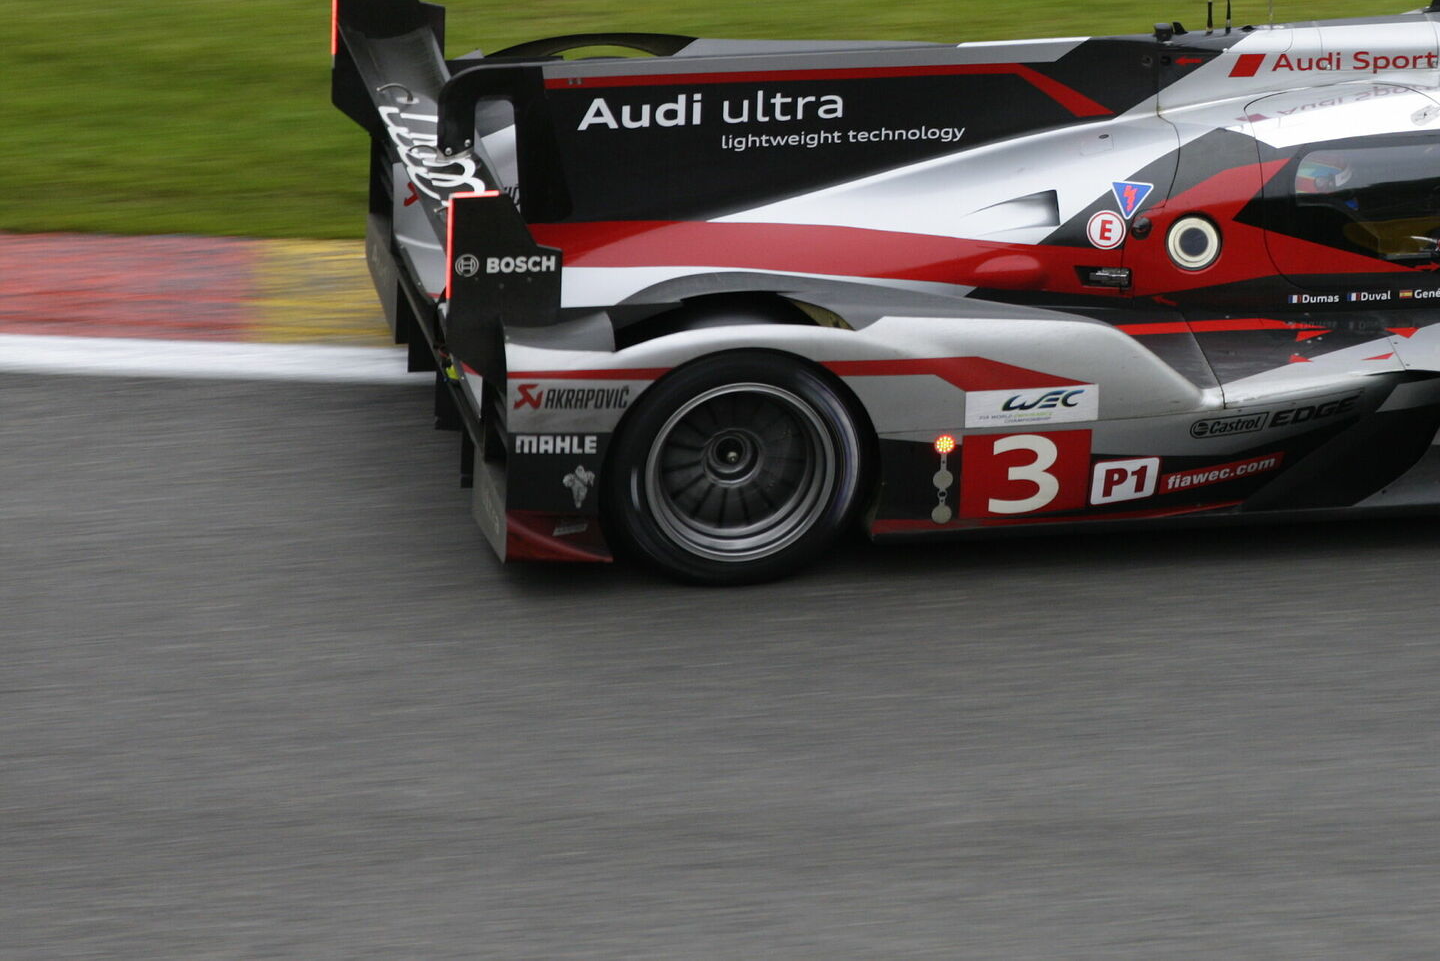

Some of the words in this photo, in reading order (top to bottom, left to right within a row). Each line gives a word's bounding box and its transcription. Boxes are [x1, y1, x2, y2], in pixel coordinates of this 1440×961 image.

[1271, 52, 1341, 72] Audi
[1353, 51, 1439, 74] Sport
[577, 92, 702, 131] Audi
[722, 89, 844, 124] ultra
[721, 128, 842, 152] lightweight
[847, 124, 966, 145] technology
[1099, 219, 1114, 241] E
[486, 255, 556, 274] BOSCH
[1302, 294, 1340, 304] Dumas
[1360, 290, 1392, 302] Duval
[1001, 389, 1086, 412] WEC
[1208, 416, 1261, 434] Castrol
[1268, 394, 1364, 428] EDGE
[515, 435, 597, 455] MAHLE
[988, 434, 1060, 514] 3
[1102, 465, 1149, 499] P1
[1166, 457, 1276, 490] fiawec.com
